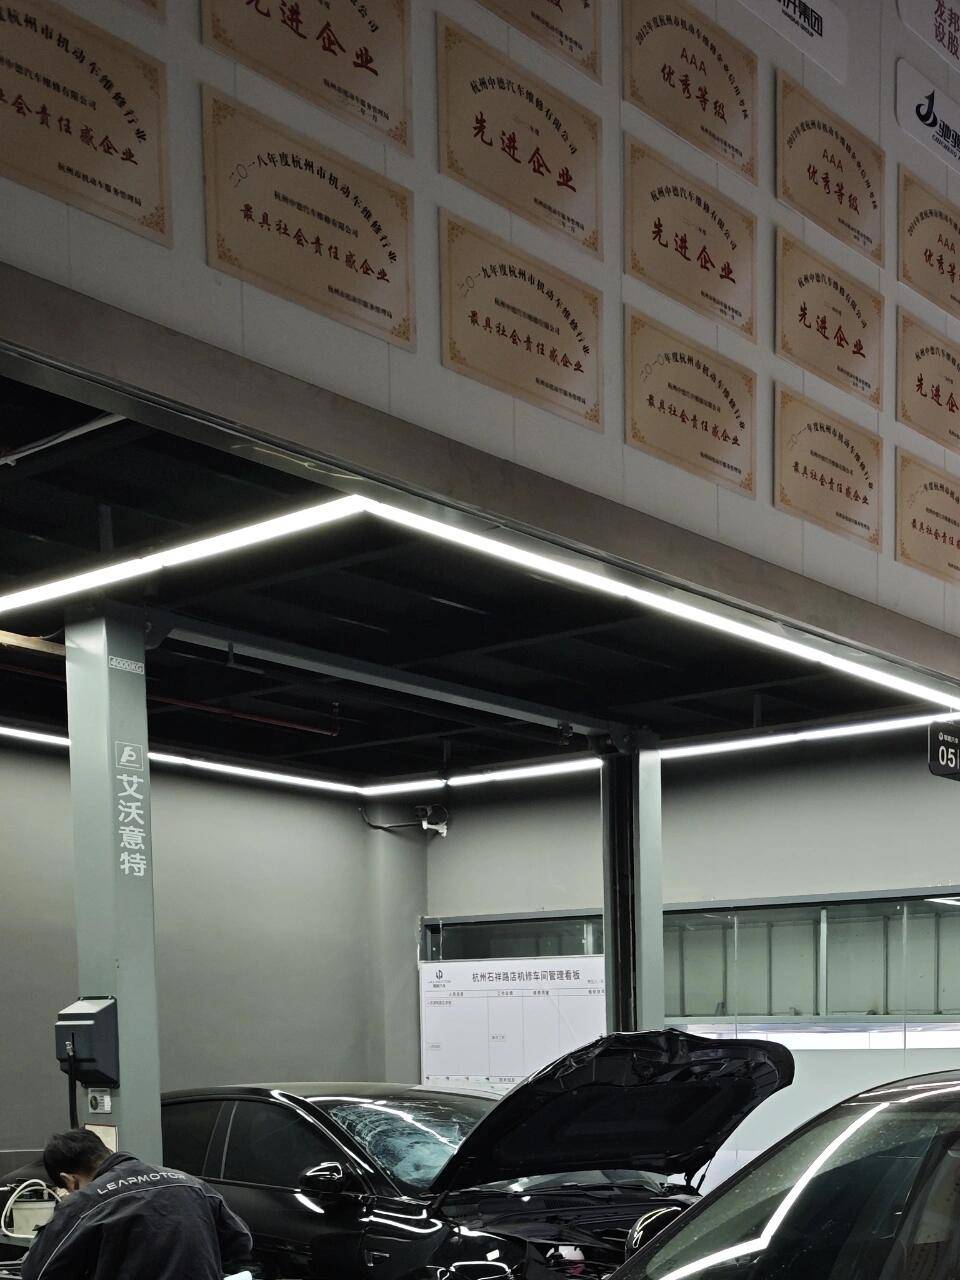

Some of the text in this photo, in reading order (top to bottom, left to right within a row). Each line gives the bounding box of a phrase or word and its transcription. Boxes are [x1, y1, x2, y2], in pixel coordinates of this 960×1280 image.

[680, 47, 707, 77] AAA
[660, 62, 728, 125] 优秀等级
[473, 111, 577, 193] 先进企业
[822, 148, 844, 174] AAA
[806, 162, 861, 217] 优秀等级
[651, 216, 737, 285] 先进企业
[938, 233, 957, 256] AAA
[798, 301, 867, 359] 先进企业
[938, 745, 956, 768] 05
[116, 773, 147, 877] 艾沃意特
